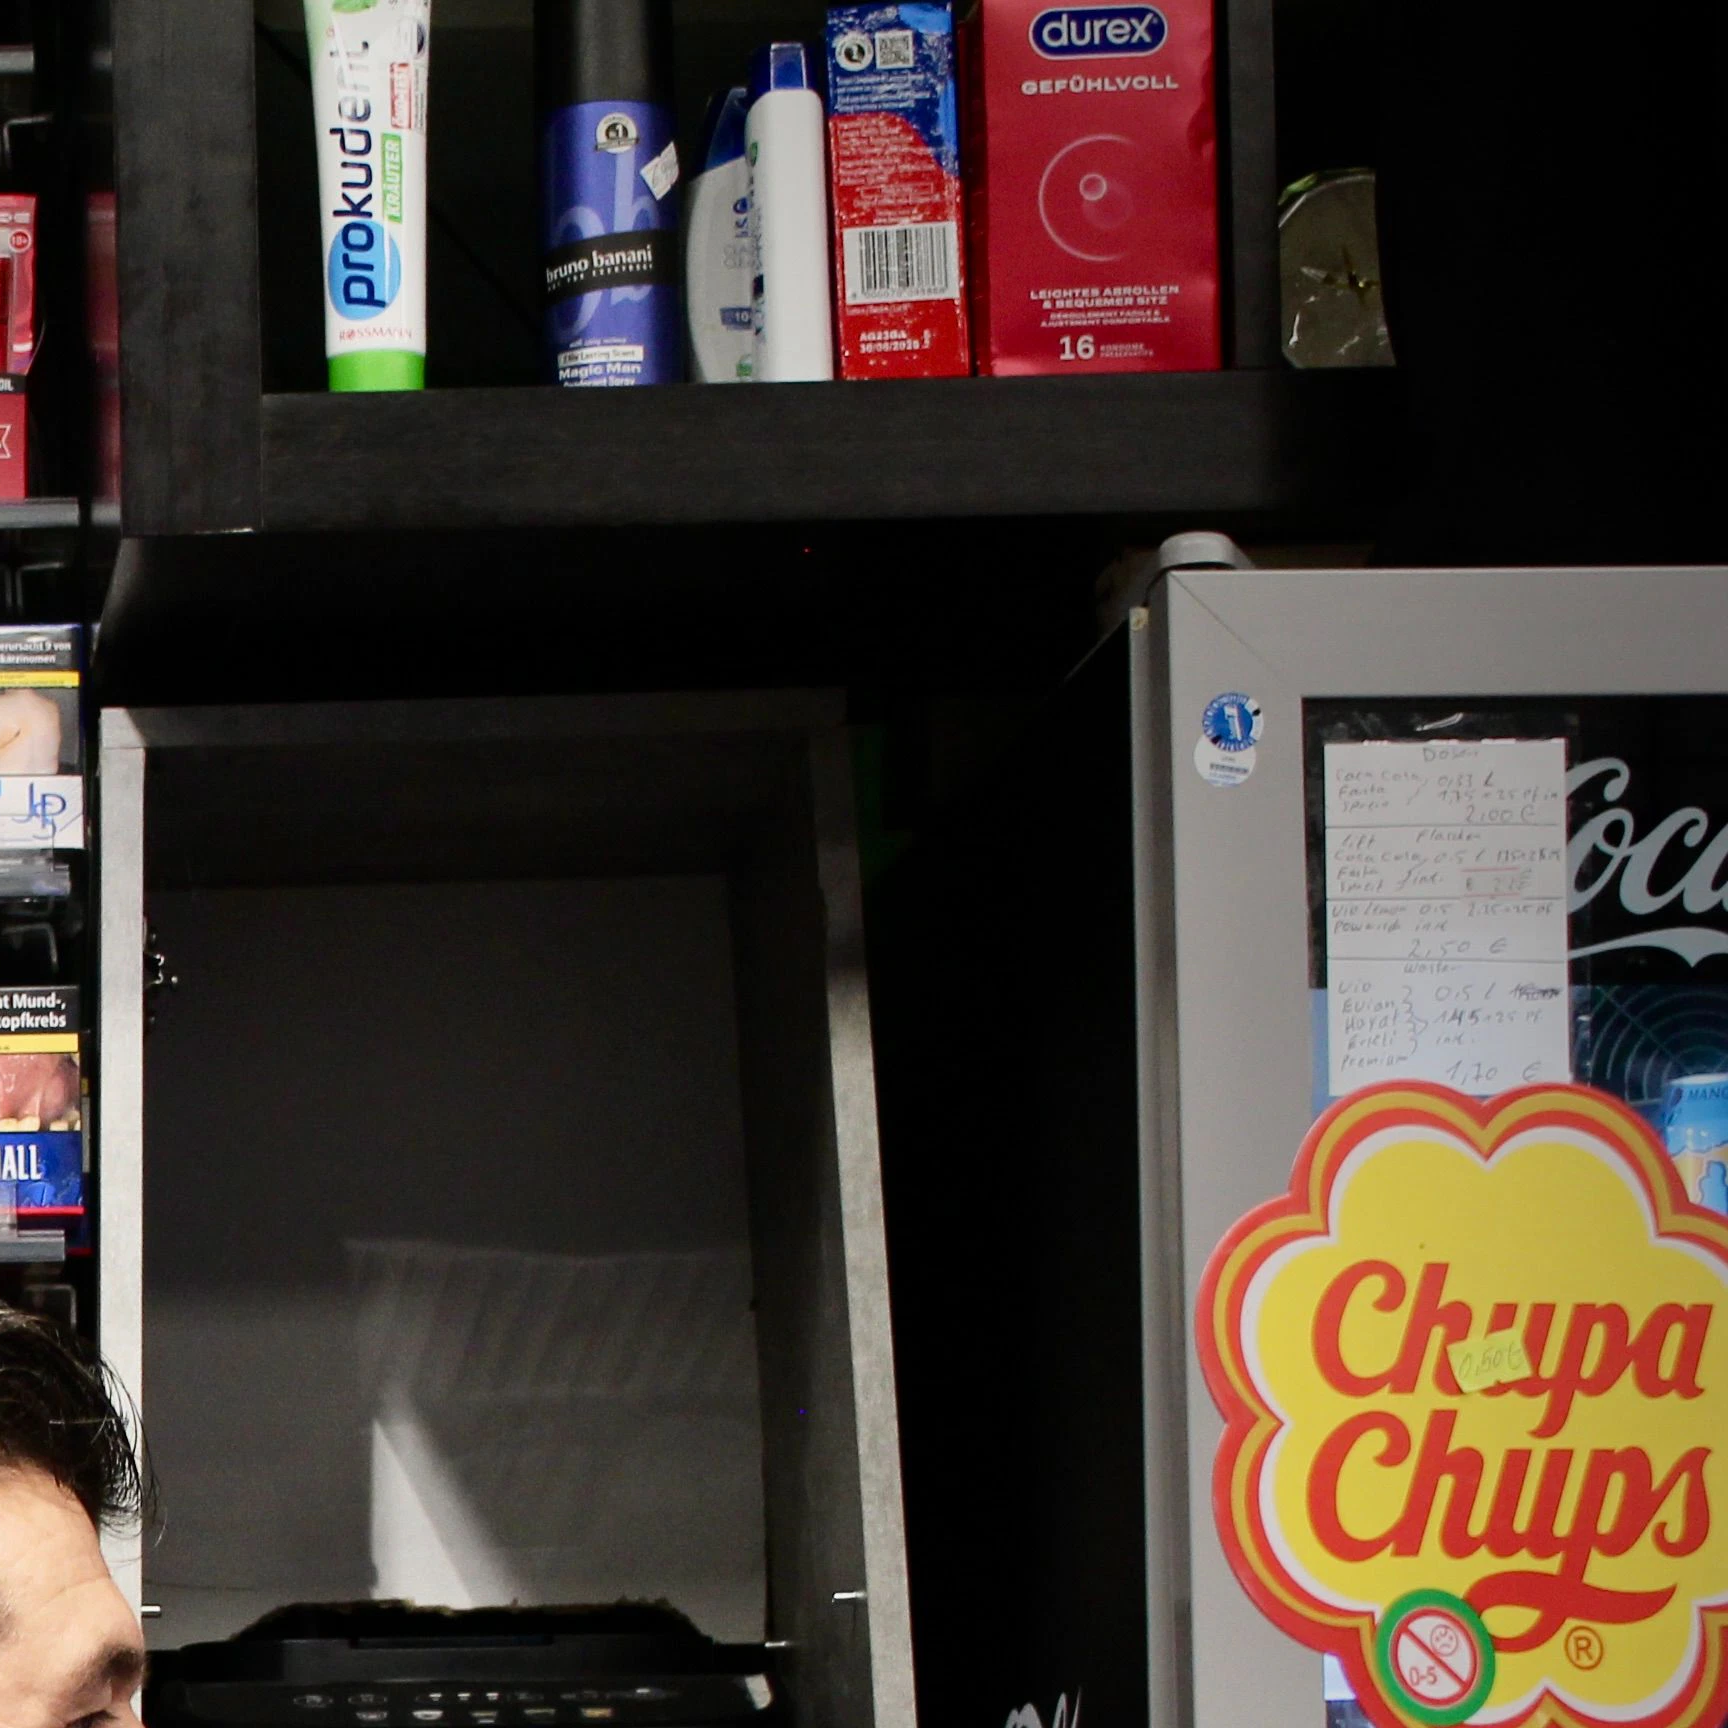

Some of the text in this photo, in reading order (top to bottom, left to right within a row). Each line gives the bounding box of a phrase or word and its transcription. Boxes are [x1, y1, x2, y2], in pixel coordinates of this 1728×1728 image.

[1043, 11, 1154, 48] durex
[1021, 75, 1179, 97] GEFÜHLVOLL
[329, 40, 388, 308] prokudent
[546, 244, 652, 286] bruno banani
[1058, 335, 1095, 361] 16
[1311, 1259, 1714, 1439] Chupa
[1306, 1409, 1712, 1591] Chups
